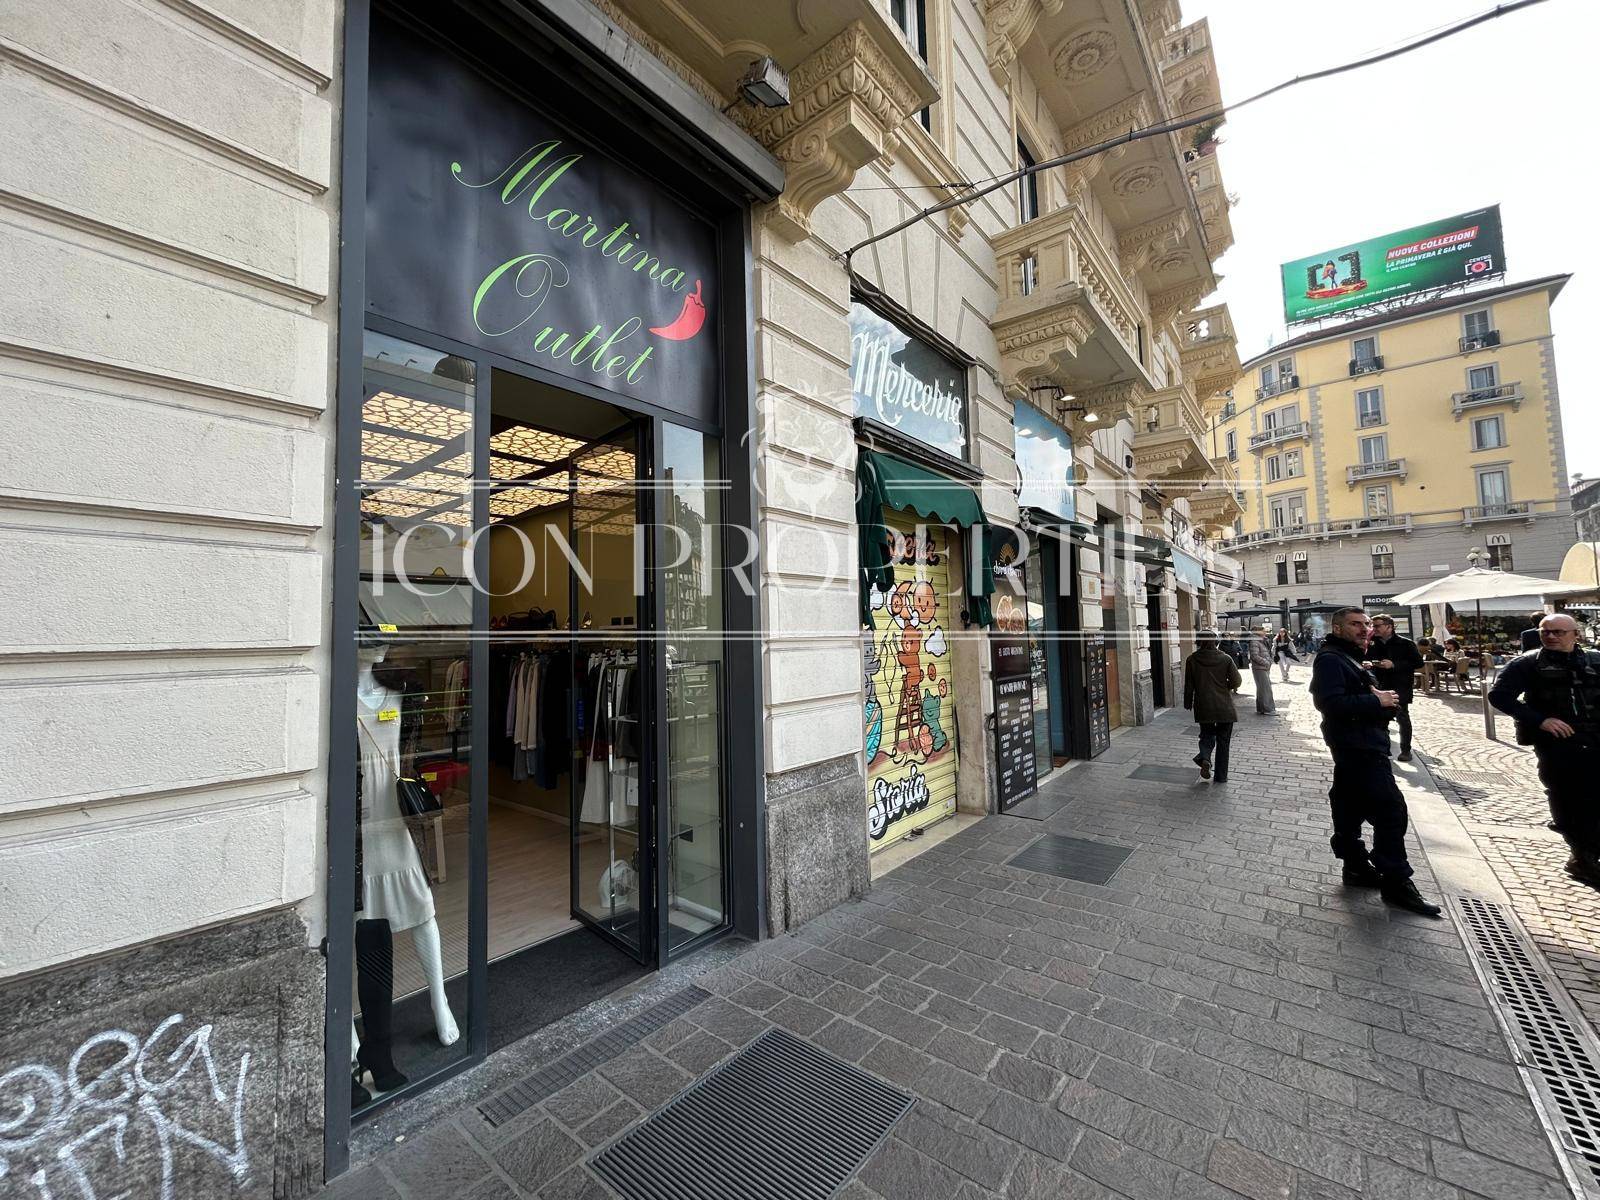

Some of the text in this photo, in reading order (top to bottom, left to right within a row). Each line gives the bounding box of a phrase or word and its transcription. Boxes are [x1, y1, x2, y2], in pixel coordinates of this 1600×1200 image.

[451, 140, 690, 292] Martina
[1387, 230, 1475, 258] NUOVE COLLEZIONI
[1396, 251, 1437, 266] PRIMAVERA
[473, 253, 653, 385] Outlet
[868, 764, 930, 840] Storia
